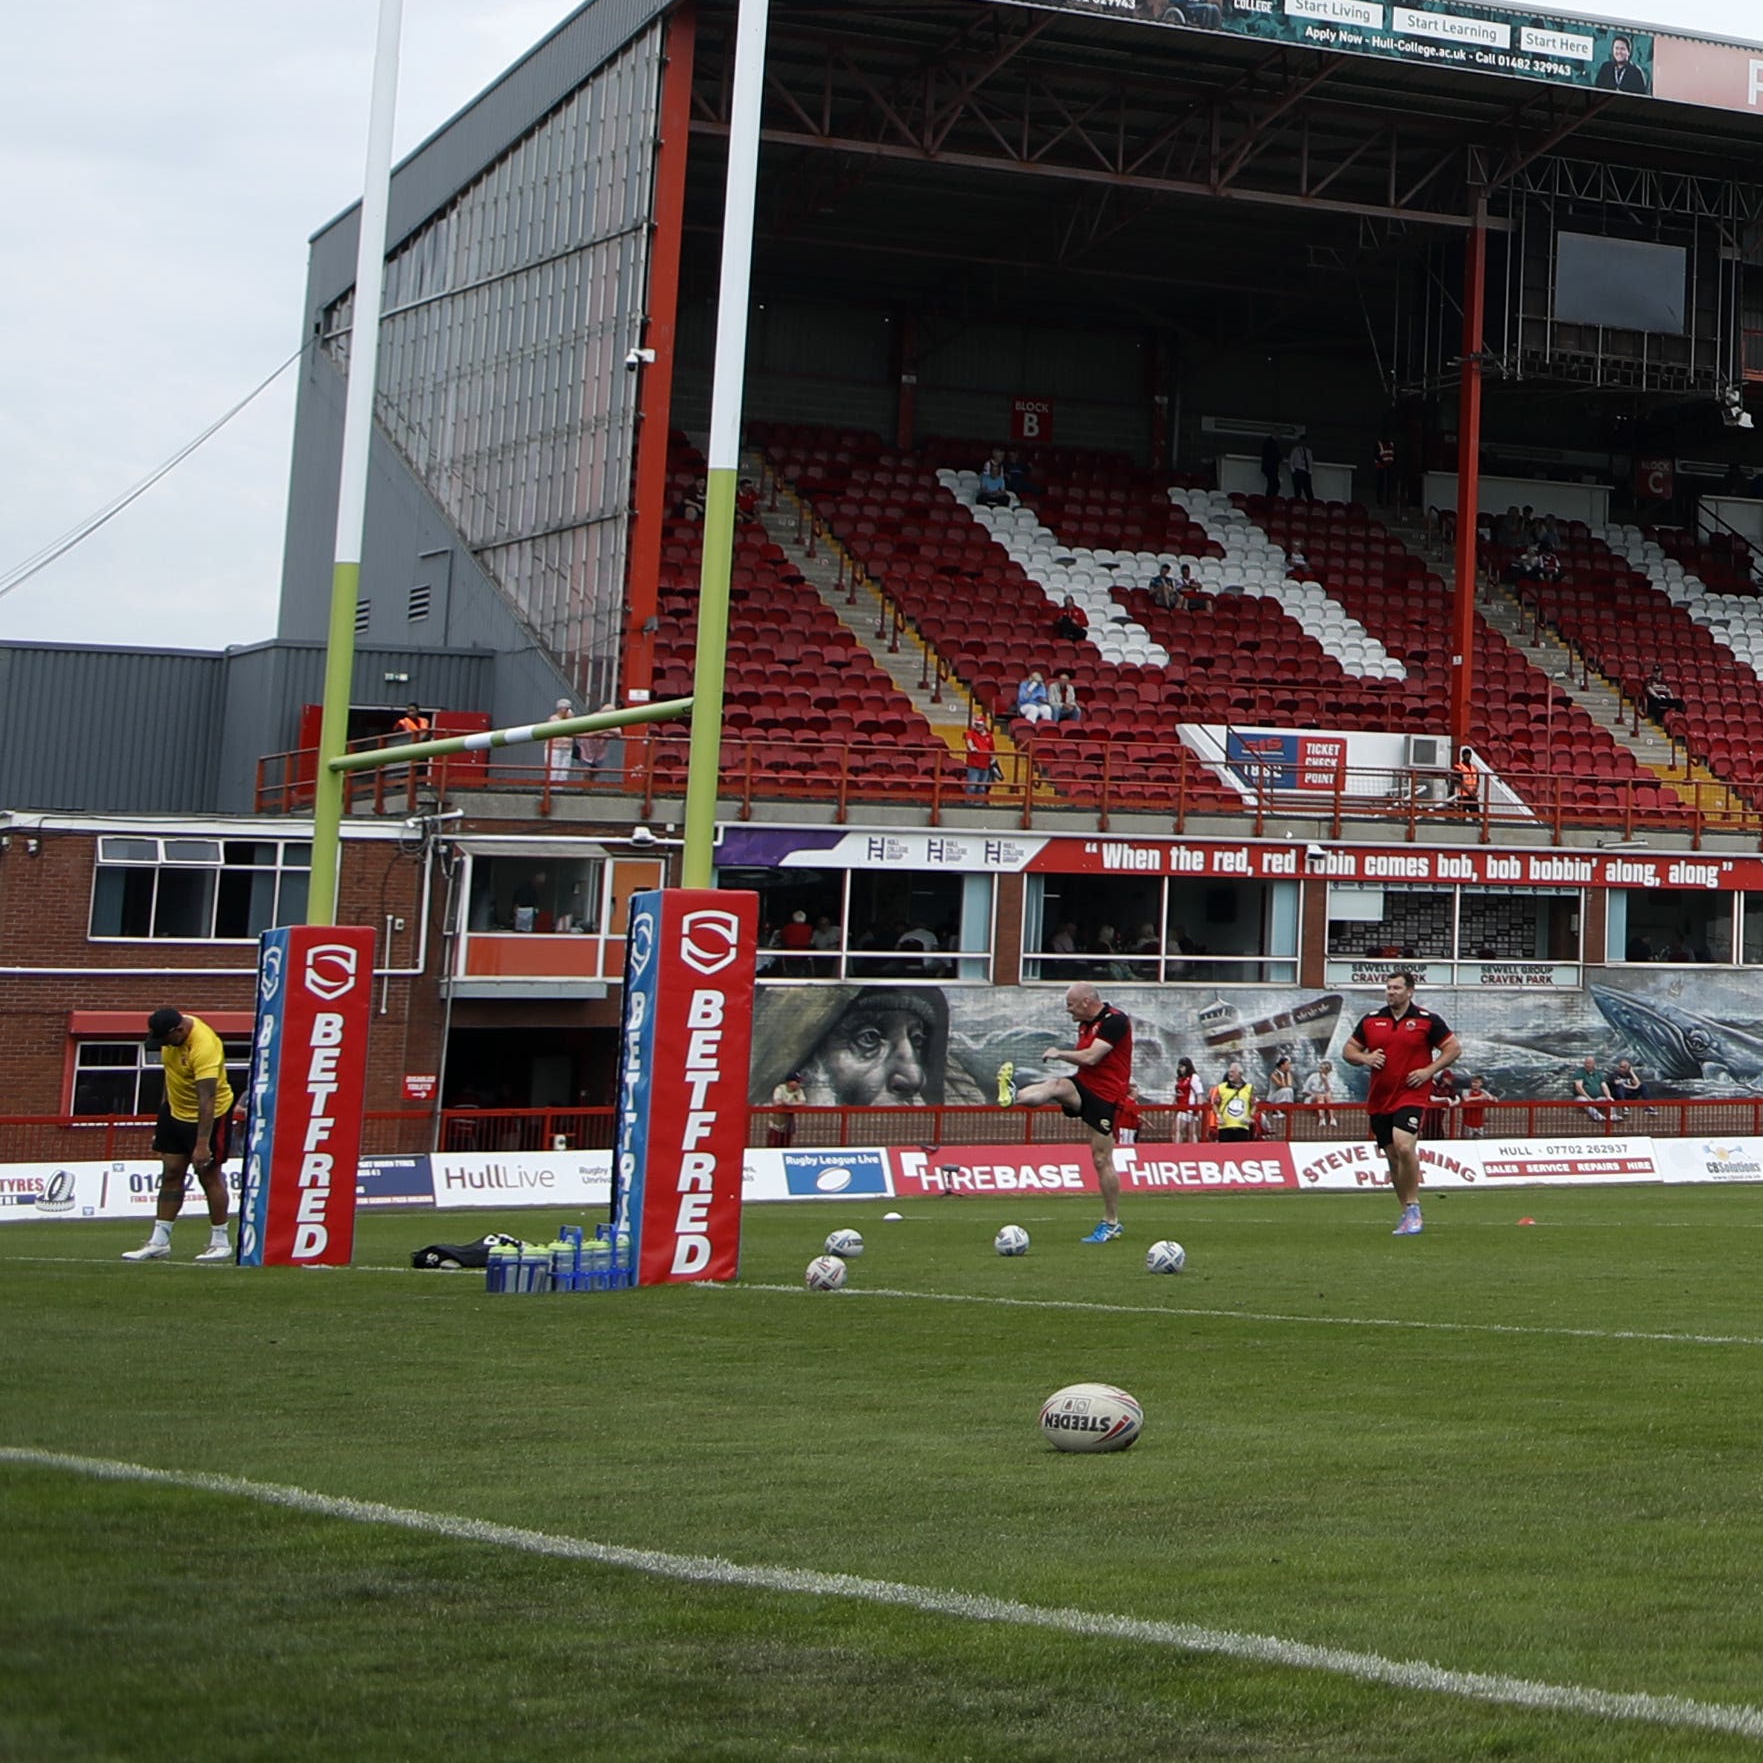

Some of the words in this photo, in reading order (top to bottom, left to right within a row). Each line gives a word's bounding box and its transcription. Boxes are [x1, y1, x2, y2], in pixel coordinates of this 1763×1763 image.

[1332, 2, 1371, 23] Living
[1407, 15, 1439, 32] Start
[1442, 19, 1497, 43] Learning
[1305, 25, 1337, 43] Apply
[1339, 32, 1364, 45] Now
[1475, 51, 1496, 66] Call
[1498, 55, 1531, 71] 01482
[1533, 61, 1572, 77] 329943
[1526, 33, 1557, 49] Start
[1560, 39, 1589, 54] Here
[1015, 400, 1049, 413] BLOCK
[1023, 411, 1041, 438] B
[1640, 459, 1670, 472] BLOCK
[1648, 471, 1664, 495] C
[1305, 742, 1342, 756] TICKET
[1305, 756, 1339, 771] CHECK
[1304, 772, 1335, 785] POINT
[1170, 845, 1204, 871] the
[1212, 847, 1254, 876] red,
[1262, 848, 1297, 873] red
[1304, 849, 1356, 876] robin
[1364, 853, 1429, 877] comes
[1437, 853, 1479, 882] bob,
[1486, 854, 1522, 880] bob
[1529, 855, 1598, 882] bobbin'
[1605, 858, 1661, 887] along,
[1352, 963, 1390, 973] SEWELL
[1392, 964, 1428, 973] GROUP
[1481, 965, 1519, 974] SEWELL
[1521, 965, 1554, 975] GROUP
[1480, 974, 1524, 984] CRAVEN
[1526, 975, 1553, 984] PARK
[243, 1014, 275, 1257] BETFRED
[292, 1012, 345, 1258] BETFRED
[671, 989, 727, 1274] BETFRED
[1500, 1146, 1533, 1156] HULL
[1546, 1145, 1583, 1156] 07702
[1586, 1143, 1628, 1154] 262937
[579, 1166, 608, 1176] Rugby
[785, 1155, 816, 1167] Rugby
[818, 1154, 858, 1167] League
[860, 1154, 879, 1165] Live
[1301, 1144, 1370, 1183] STEVE
[1485, 1164, 1519, 1175] SALES
[1525, 1162, 1570, 1174] SERVICE
[1577, 1161, 1620, 1173] REPAIRS
[1627, 1160, 1652, 1171] HIRE
[445, 1163, 555, 1190] HullLive
[1129, 1160, 1285, 1187] HIREBASE
[0, 1177, 45, 1193] TYRES
[1044, 1412, 1112, 1433] STEEDEN
